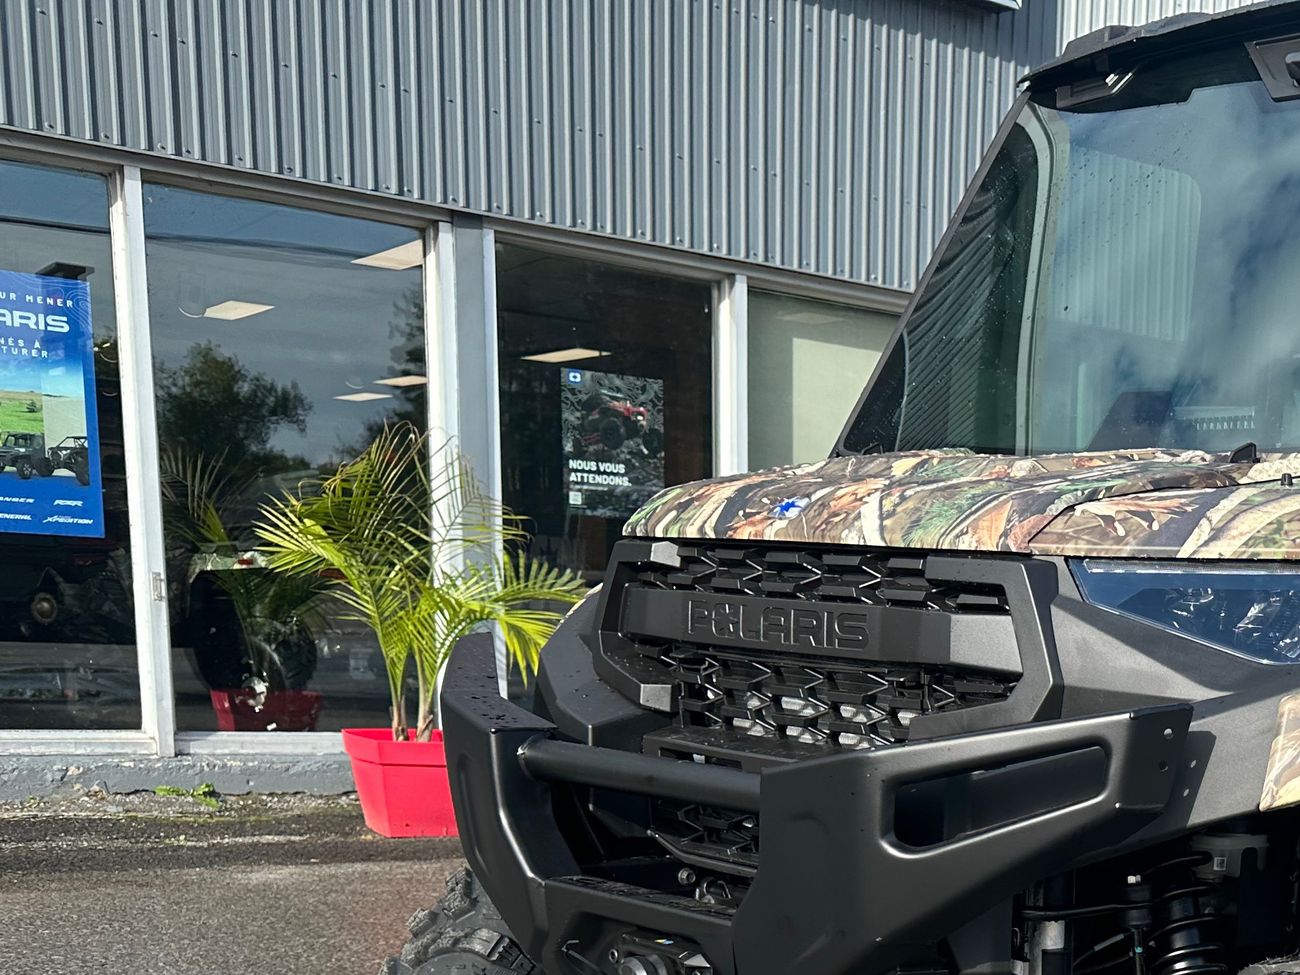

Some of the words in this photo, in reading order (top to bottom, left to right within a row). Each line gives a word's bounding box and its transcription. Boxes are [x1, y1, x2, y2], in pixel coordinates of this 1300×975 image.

[26, 294, 73, 308] MENER
[568, 459, 597, 471] NOUS
[598, 461, 626, 474] VOUS
[569, 471, 632, 487] ATTENDONS.
[42, 515, 94, 525] XPEDITION
[688, 599, 872, 651] POLARIS
